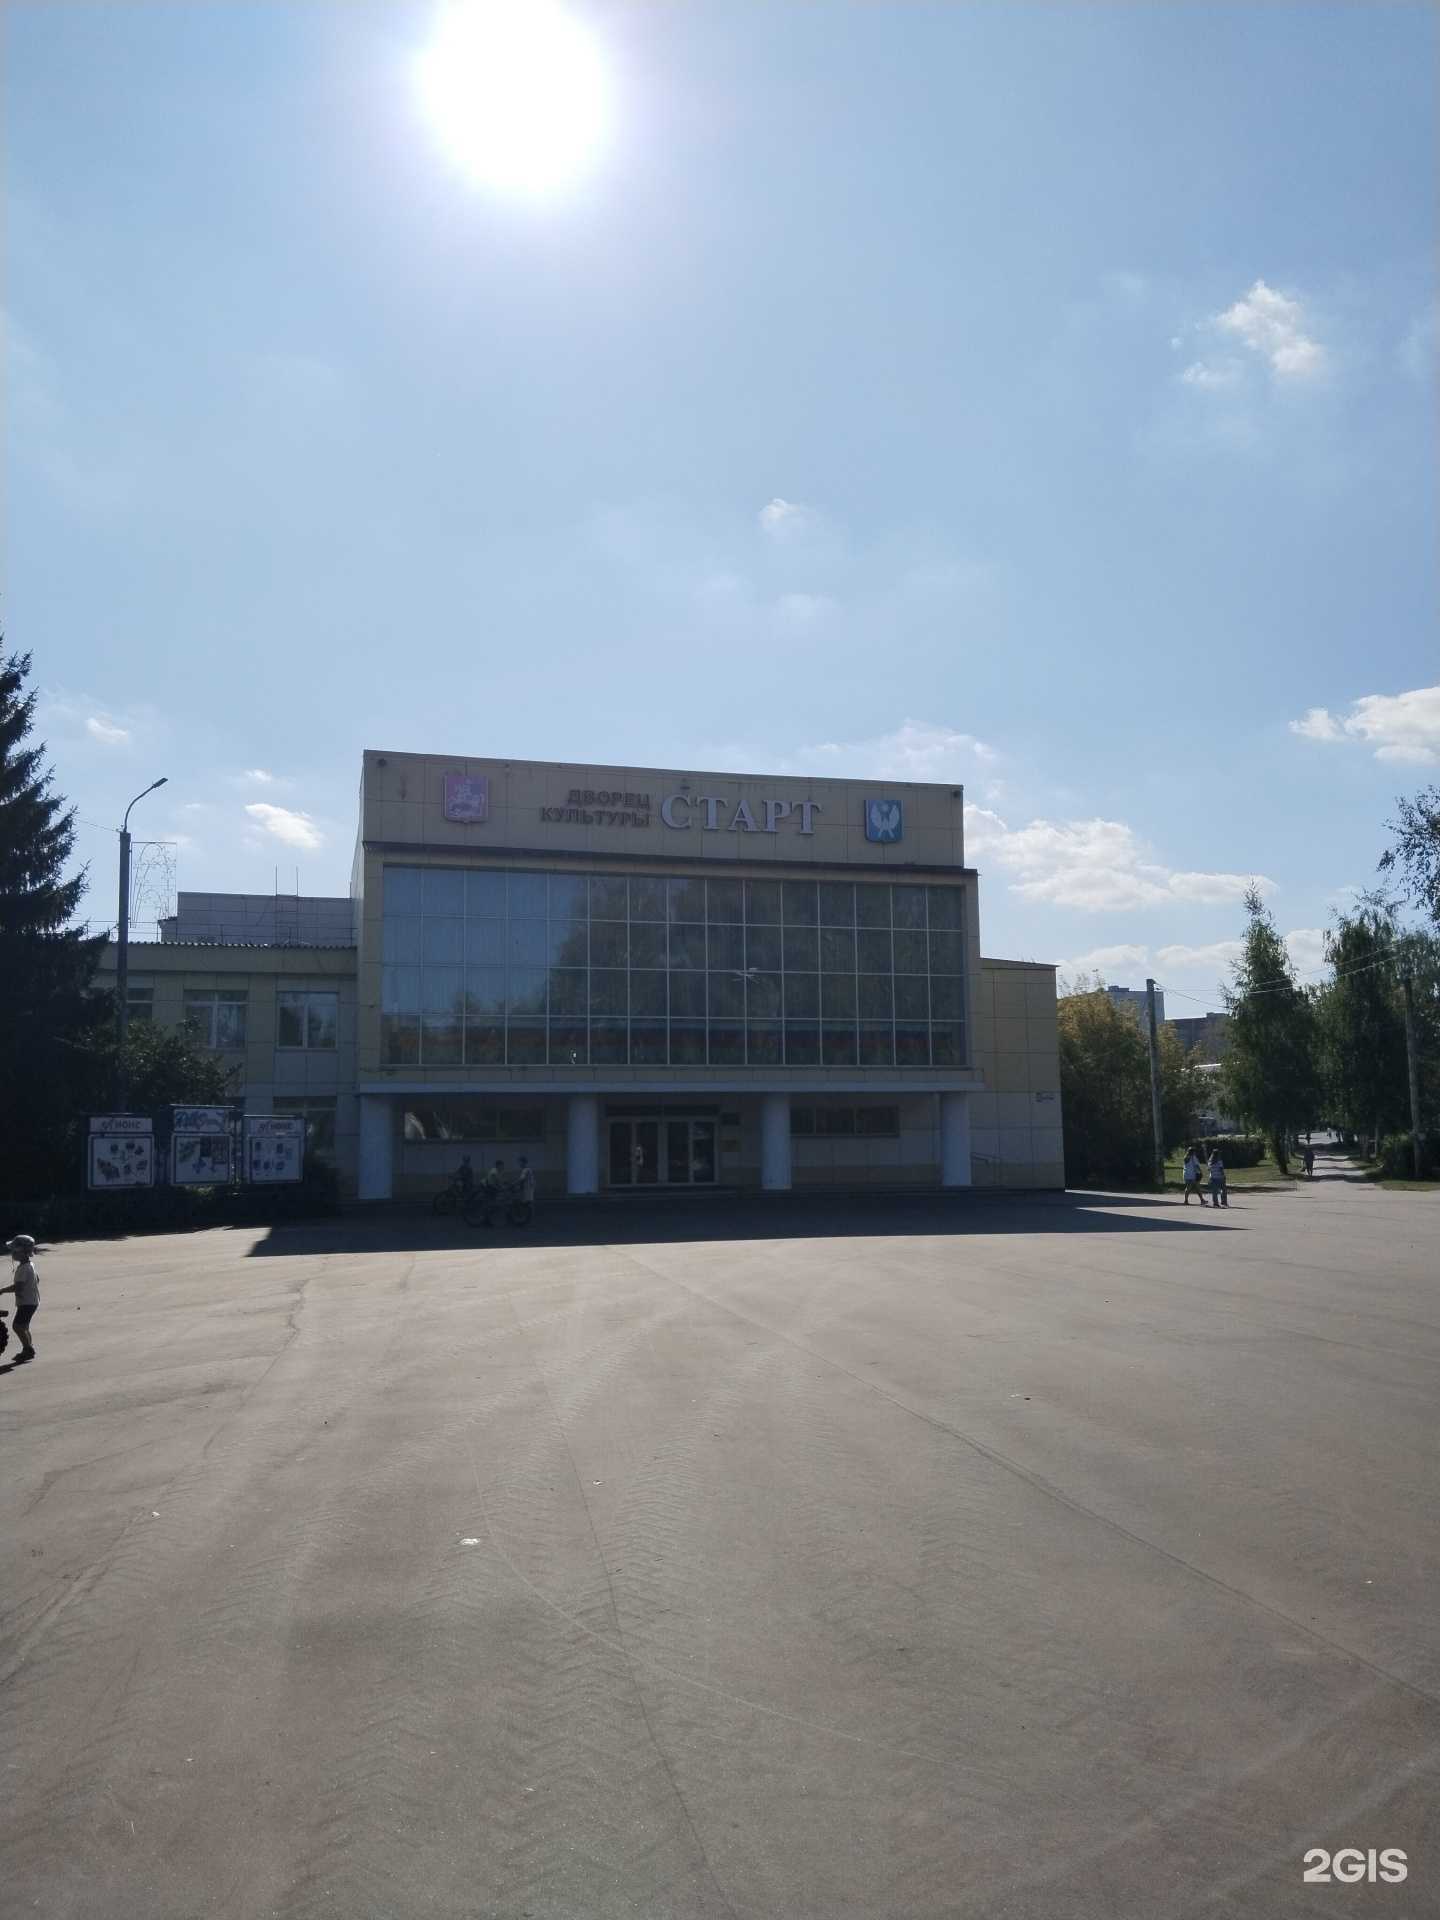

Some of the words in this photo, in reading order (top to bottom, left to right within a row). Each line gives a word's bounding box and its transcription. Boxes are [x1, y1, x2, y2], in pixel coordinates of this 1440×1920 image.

[567, 789, 650, 809] ДВОРЕЦ
[540, 807, 650, 827] КУЛЬТУРЫ
[661, 794, 821, 834] СТАРТ
